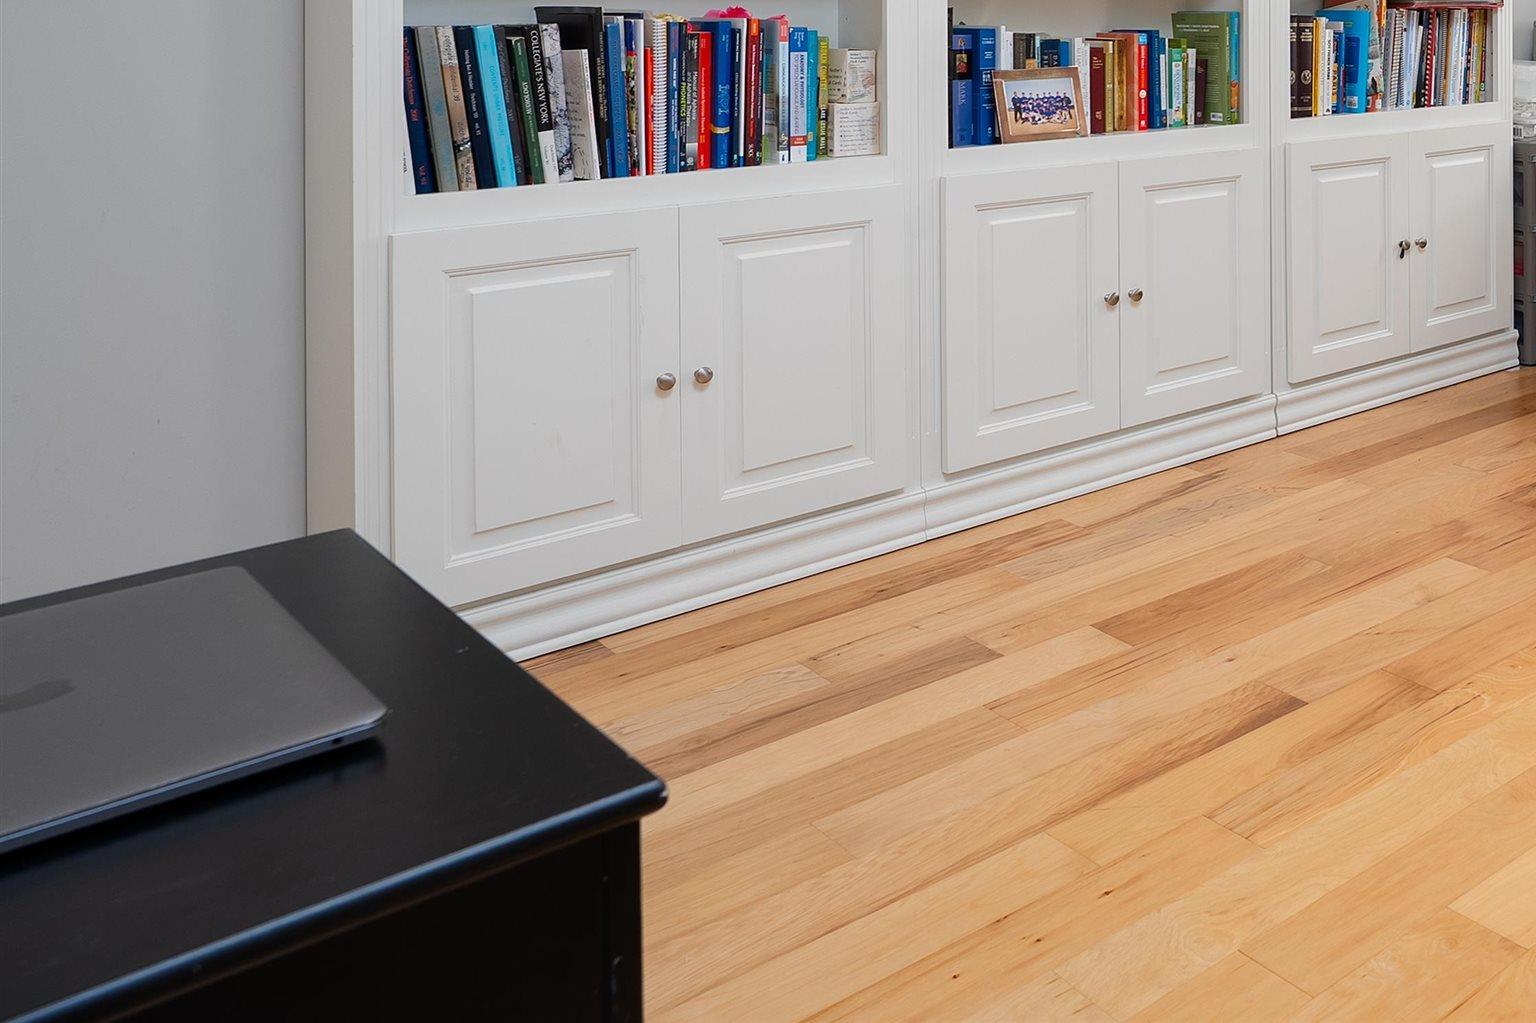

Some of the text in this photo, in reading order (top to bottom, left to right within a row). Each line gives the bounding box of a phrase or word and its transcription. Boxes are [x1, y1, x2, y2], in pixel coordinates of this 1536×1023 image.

[443, 34, 454, 61] collegiate
[463, 49, 471, 64] Nothing
[529, 30, 549, 124] COLLEGIATE'S NEW YORK
[522, 81, 532, 115] AUDIOLOGY
